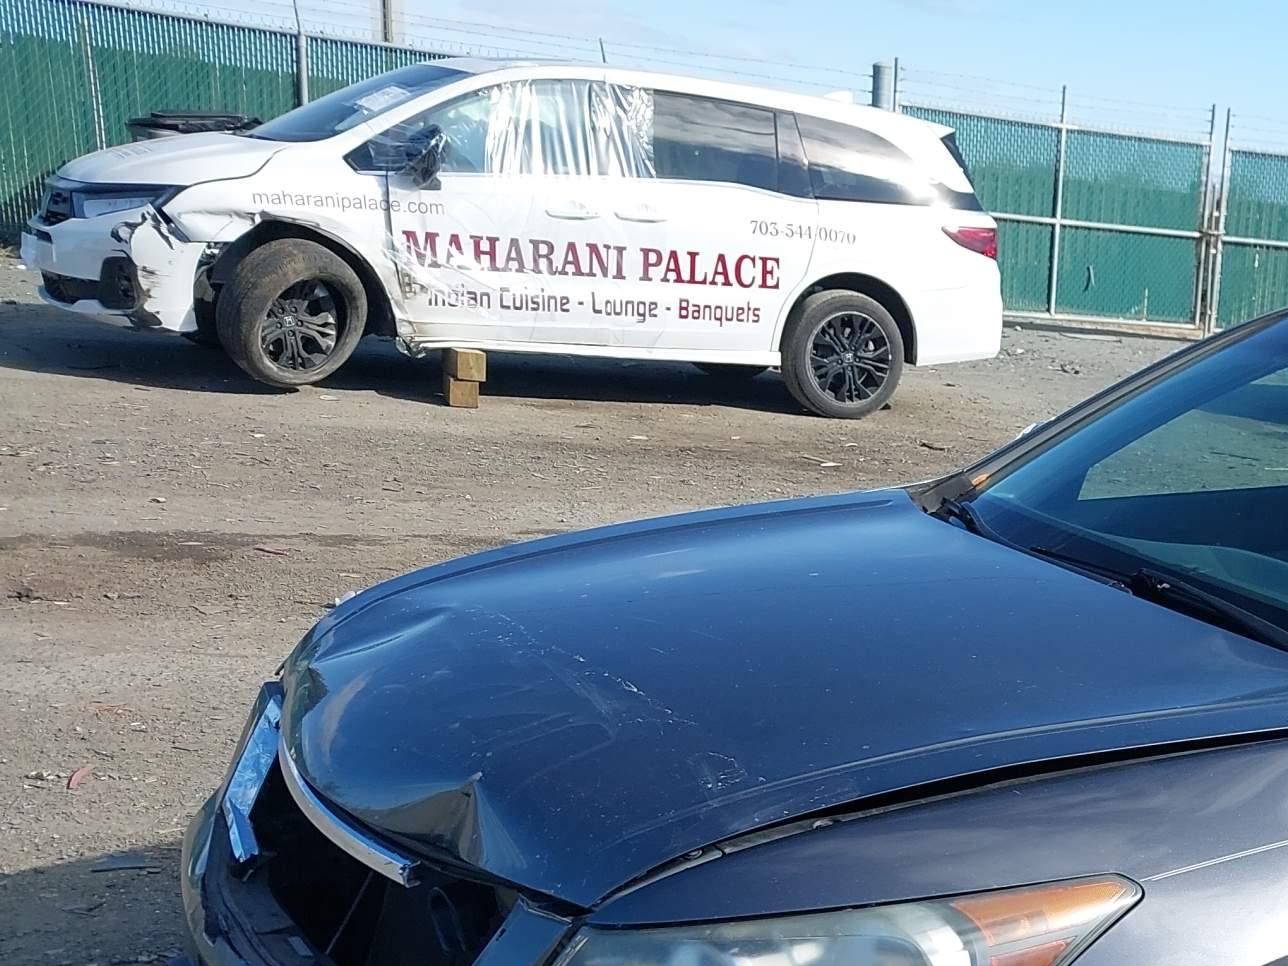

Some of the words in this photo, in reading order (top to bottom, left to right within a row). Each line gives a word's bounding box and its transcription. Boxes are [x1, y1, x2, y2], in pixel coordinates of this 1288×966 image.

[252, 191, 446, 215] maharanipalace.com
[402, 230, 627, 280] MAHARANI
[639, 247, 780, 289] PALACE
[499, 286, 570, 313] Cuisine
[591, 291, 658, 323] Lounge
[679, 298, 761, 326] Banquets
